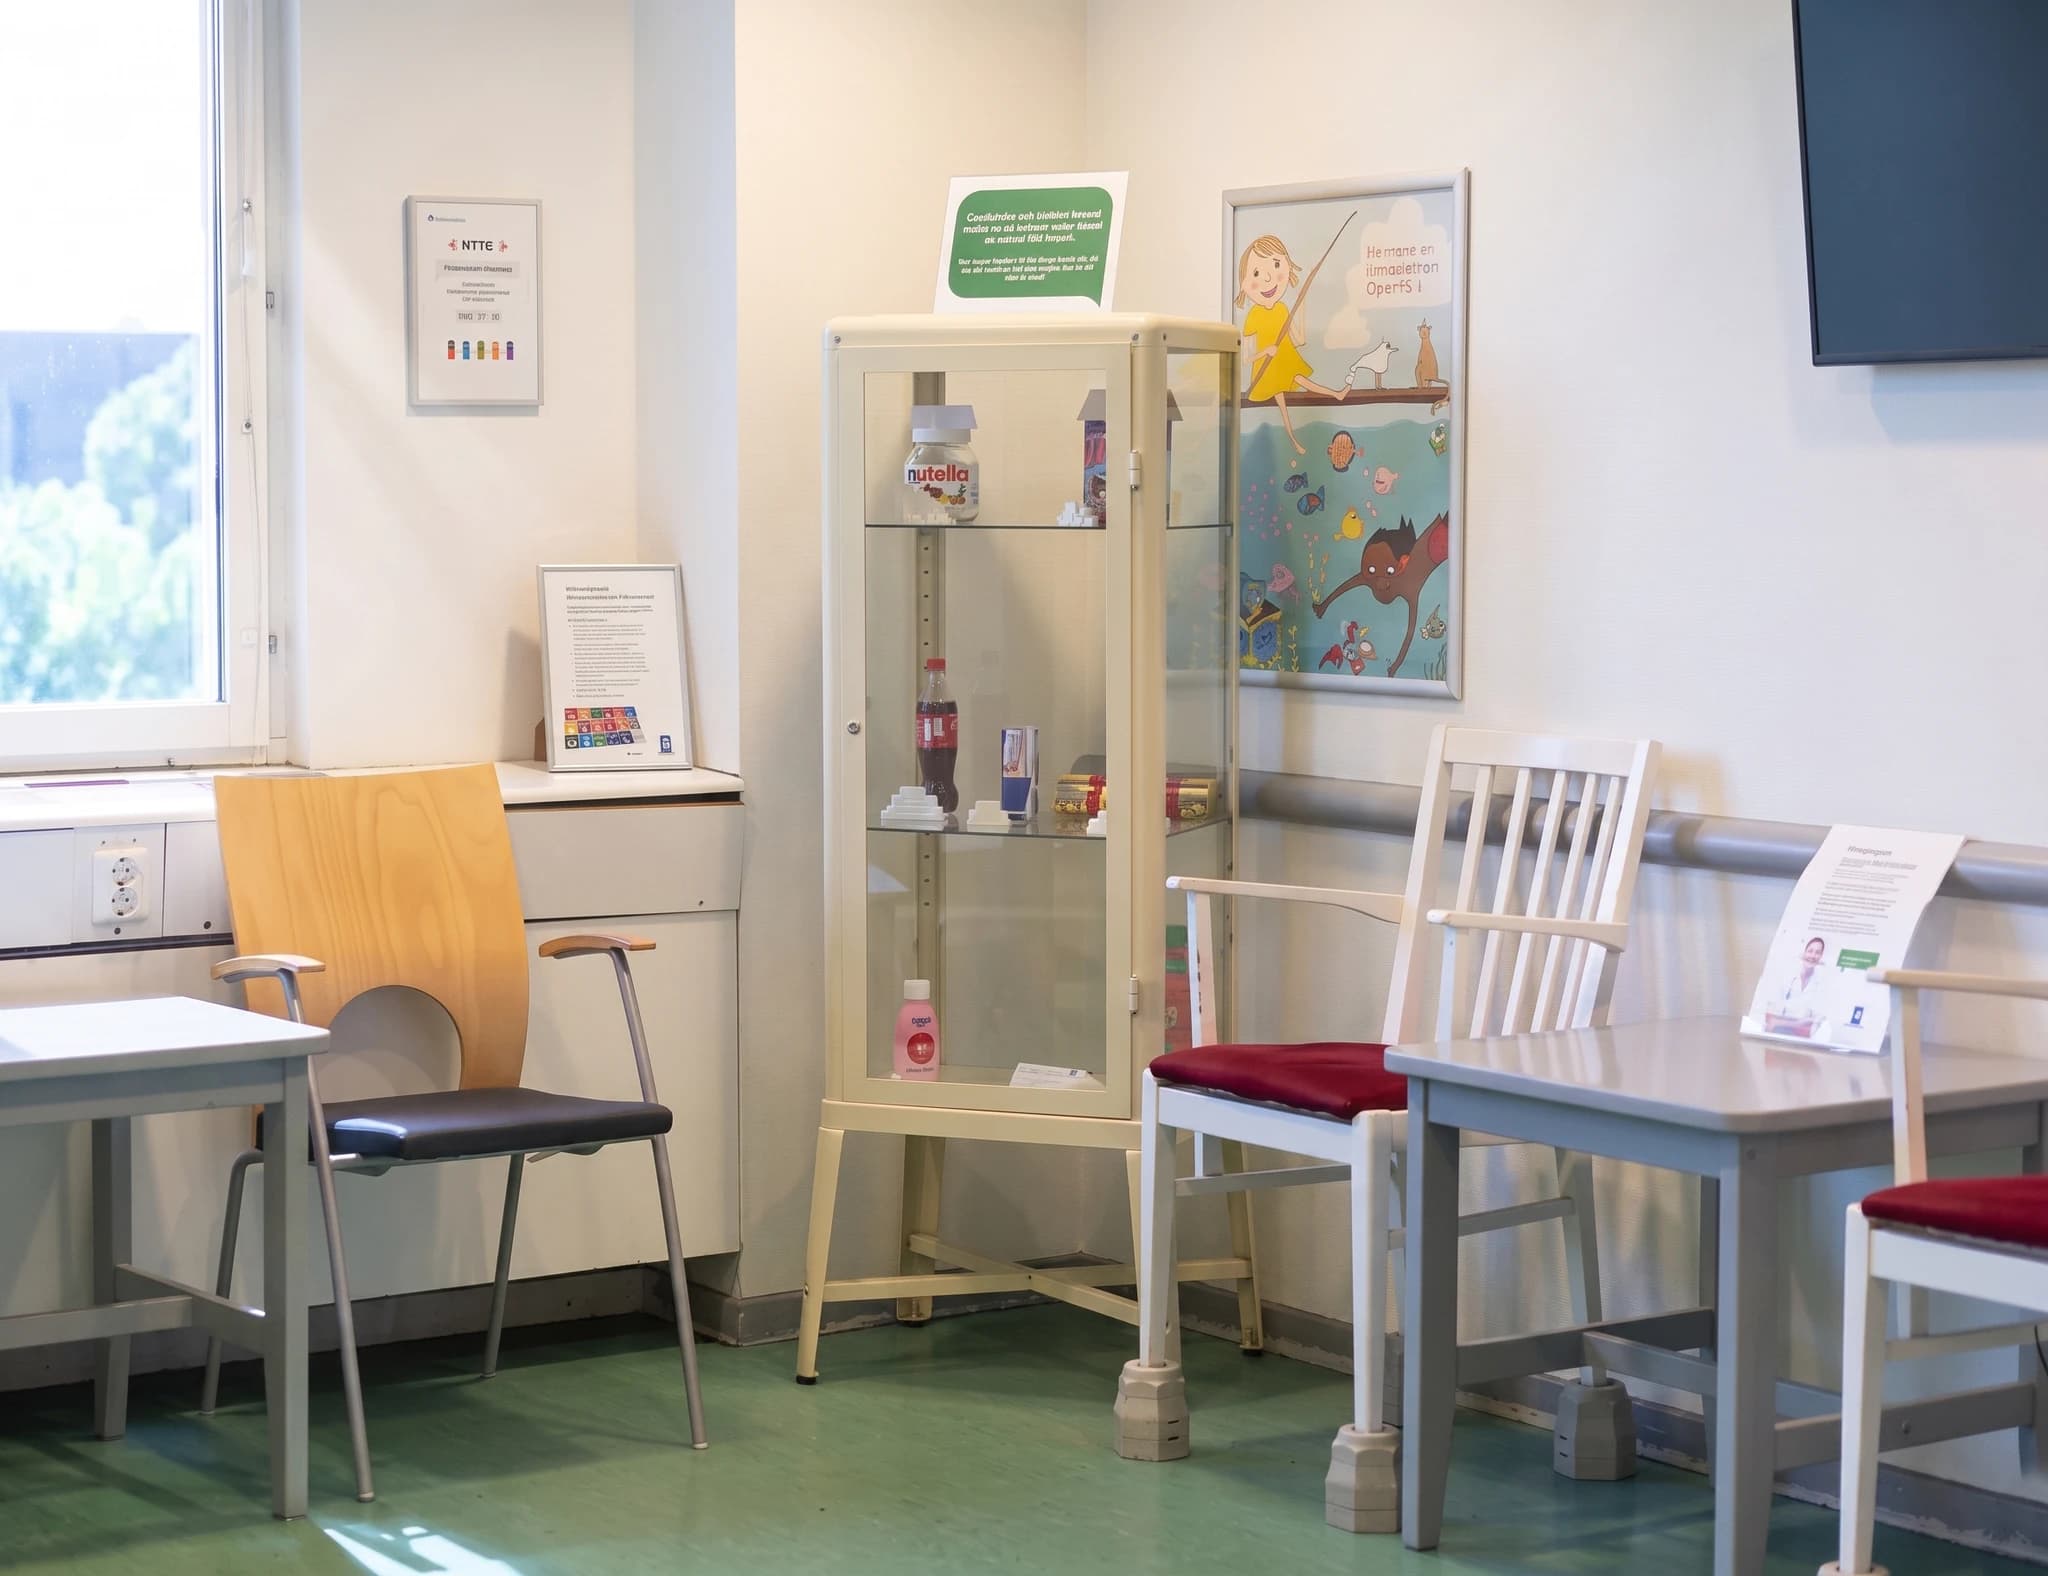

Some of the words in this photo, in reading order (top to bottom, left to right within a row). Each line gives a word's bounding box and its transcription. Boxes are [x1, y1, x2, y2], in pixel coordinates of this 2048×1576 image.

[1367, 246, 1382, 258] He
[1420, 245, 1435, 256] en
[907, 464, 969, 483] nutella
